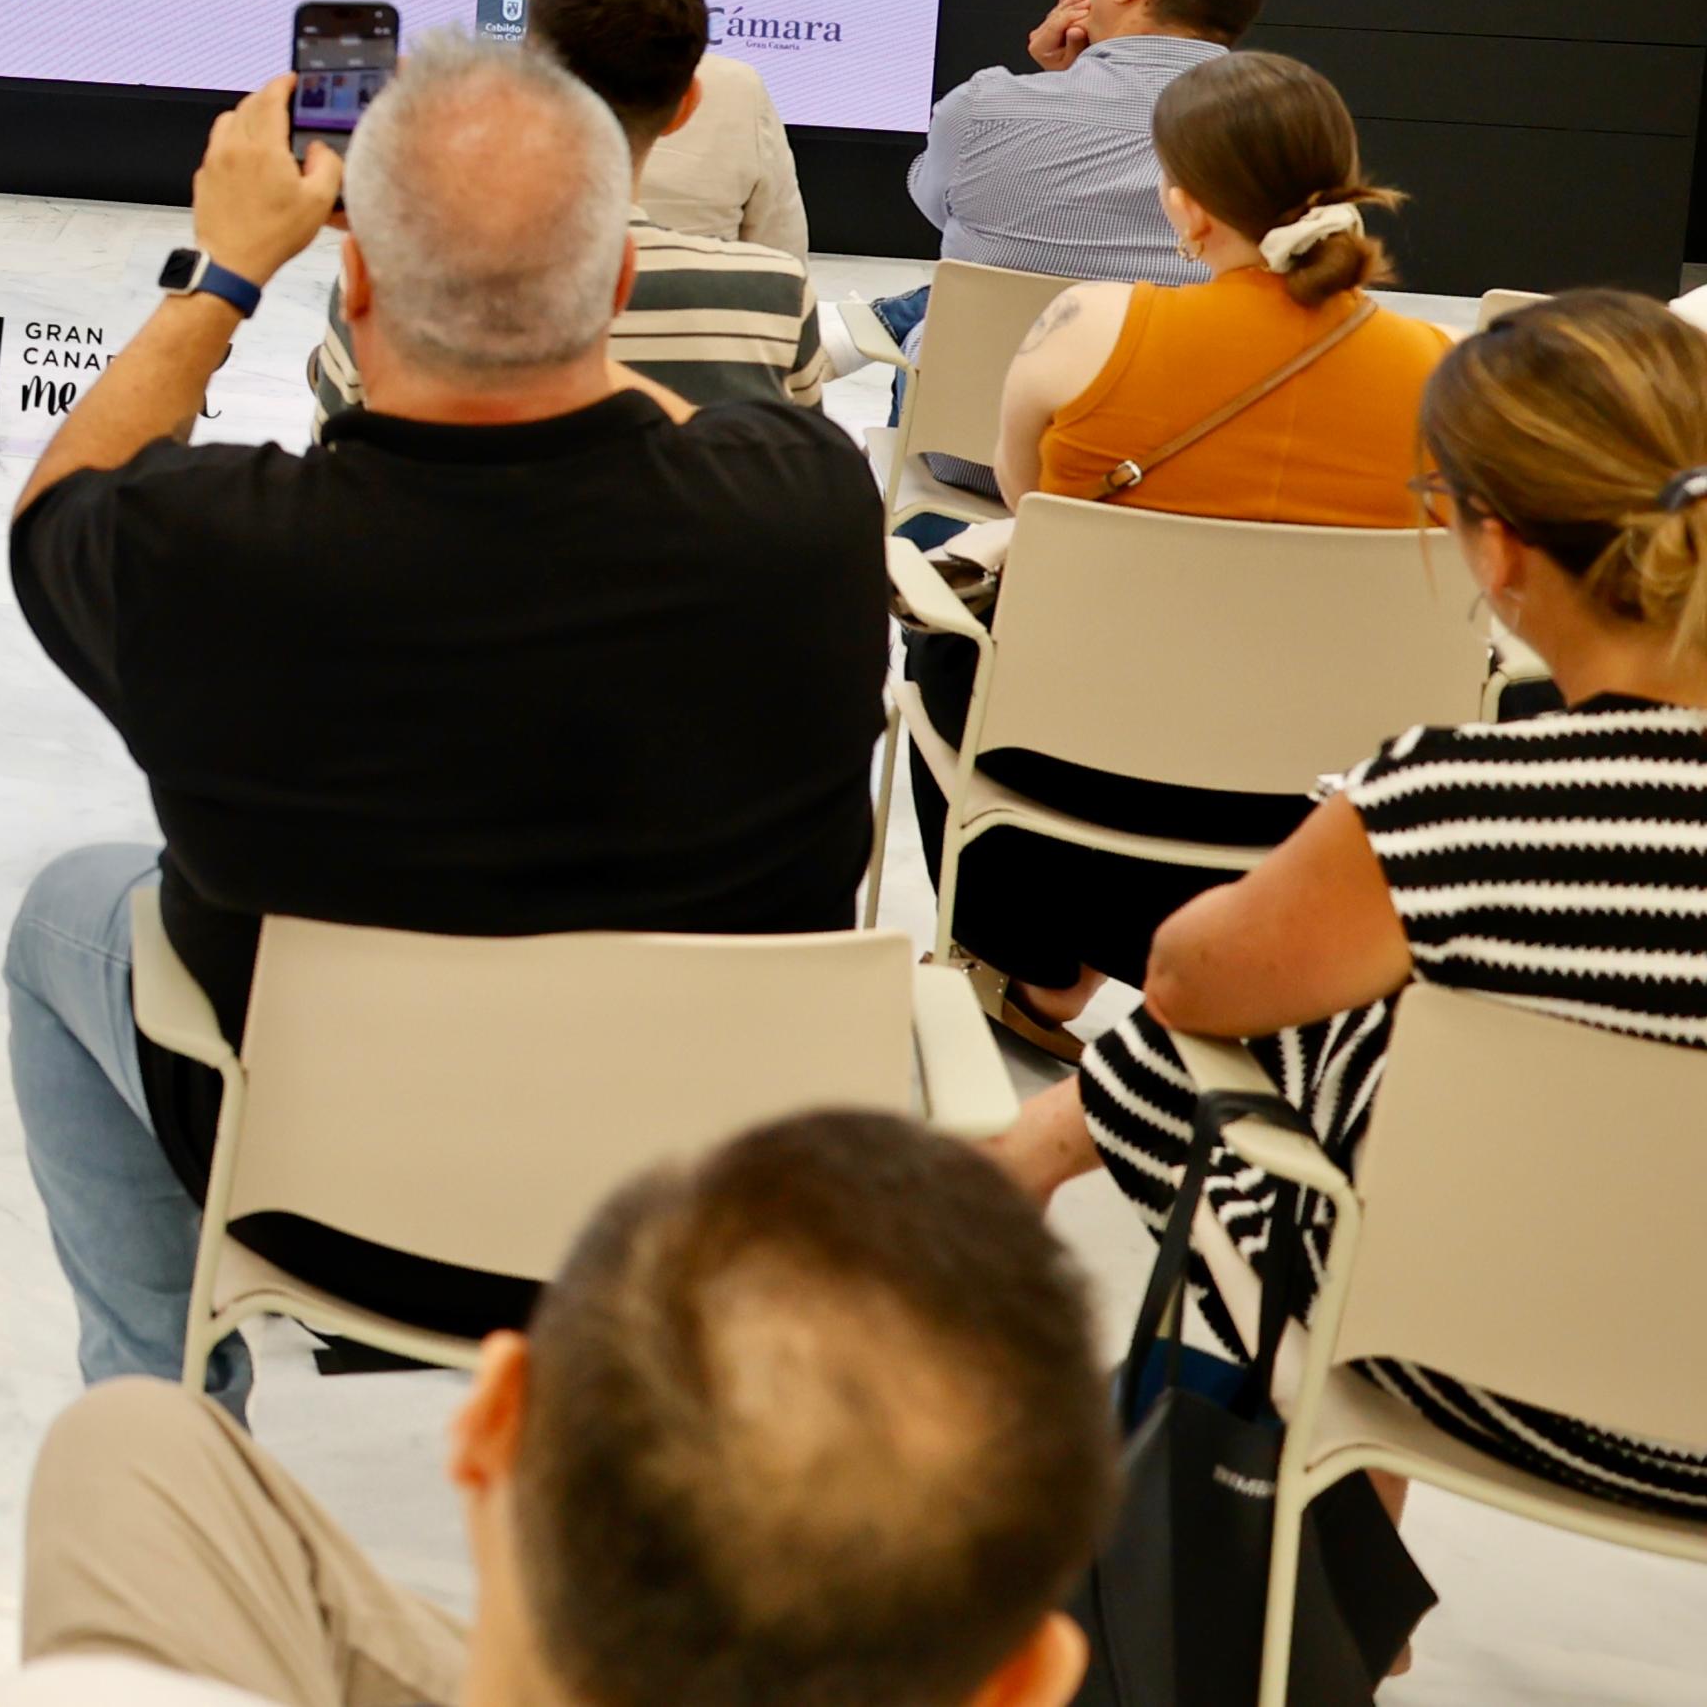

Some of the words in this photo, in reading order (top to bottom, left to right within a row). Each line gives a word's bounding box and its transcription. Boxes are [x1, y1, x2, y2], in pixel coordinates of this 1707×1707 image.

[485, 22, 522, 34] Cabildo
[25, 322, 103, 345] GRAN
[21, 375, 77, 416] me
